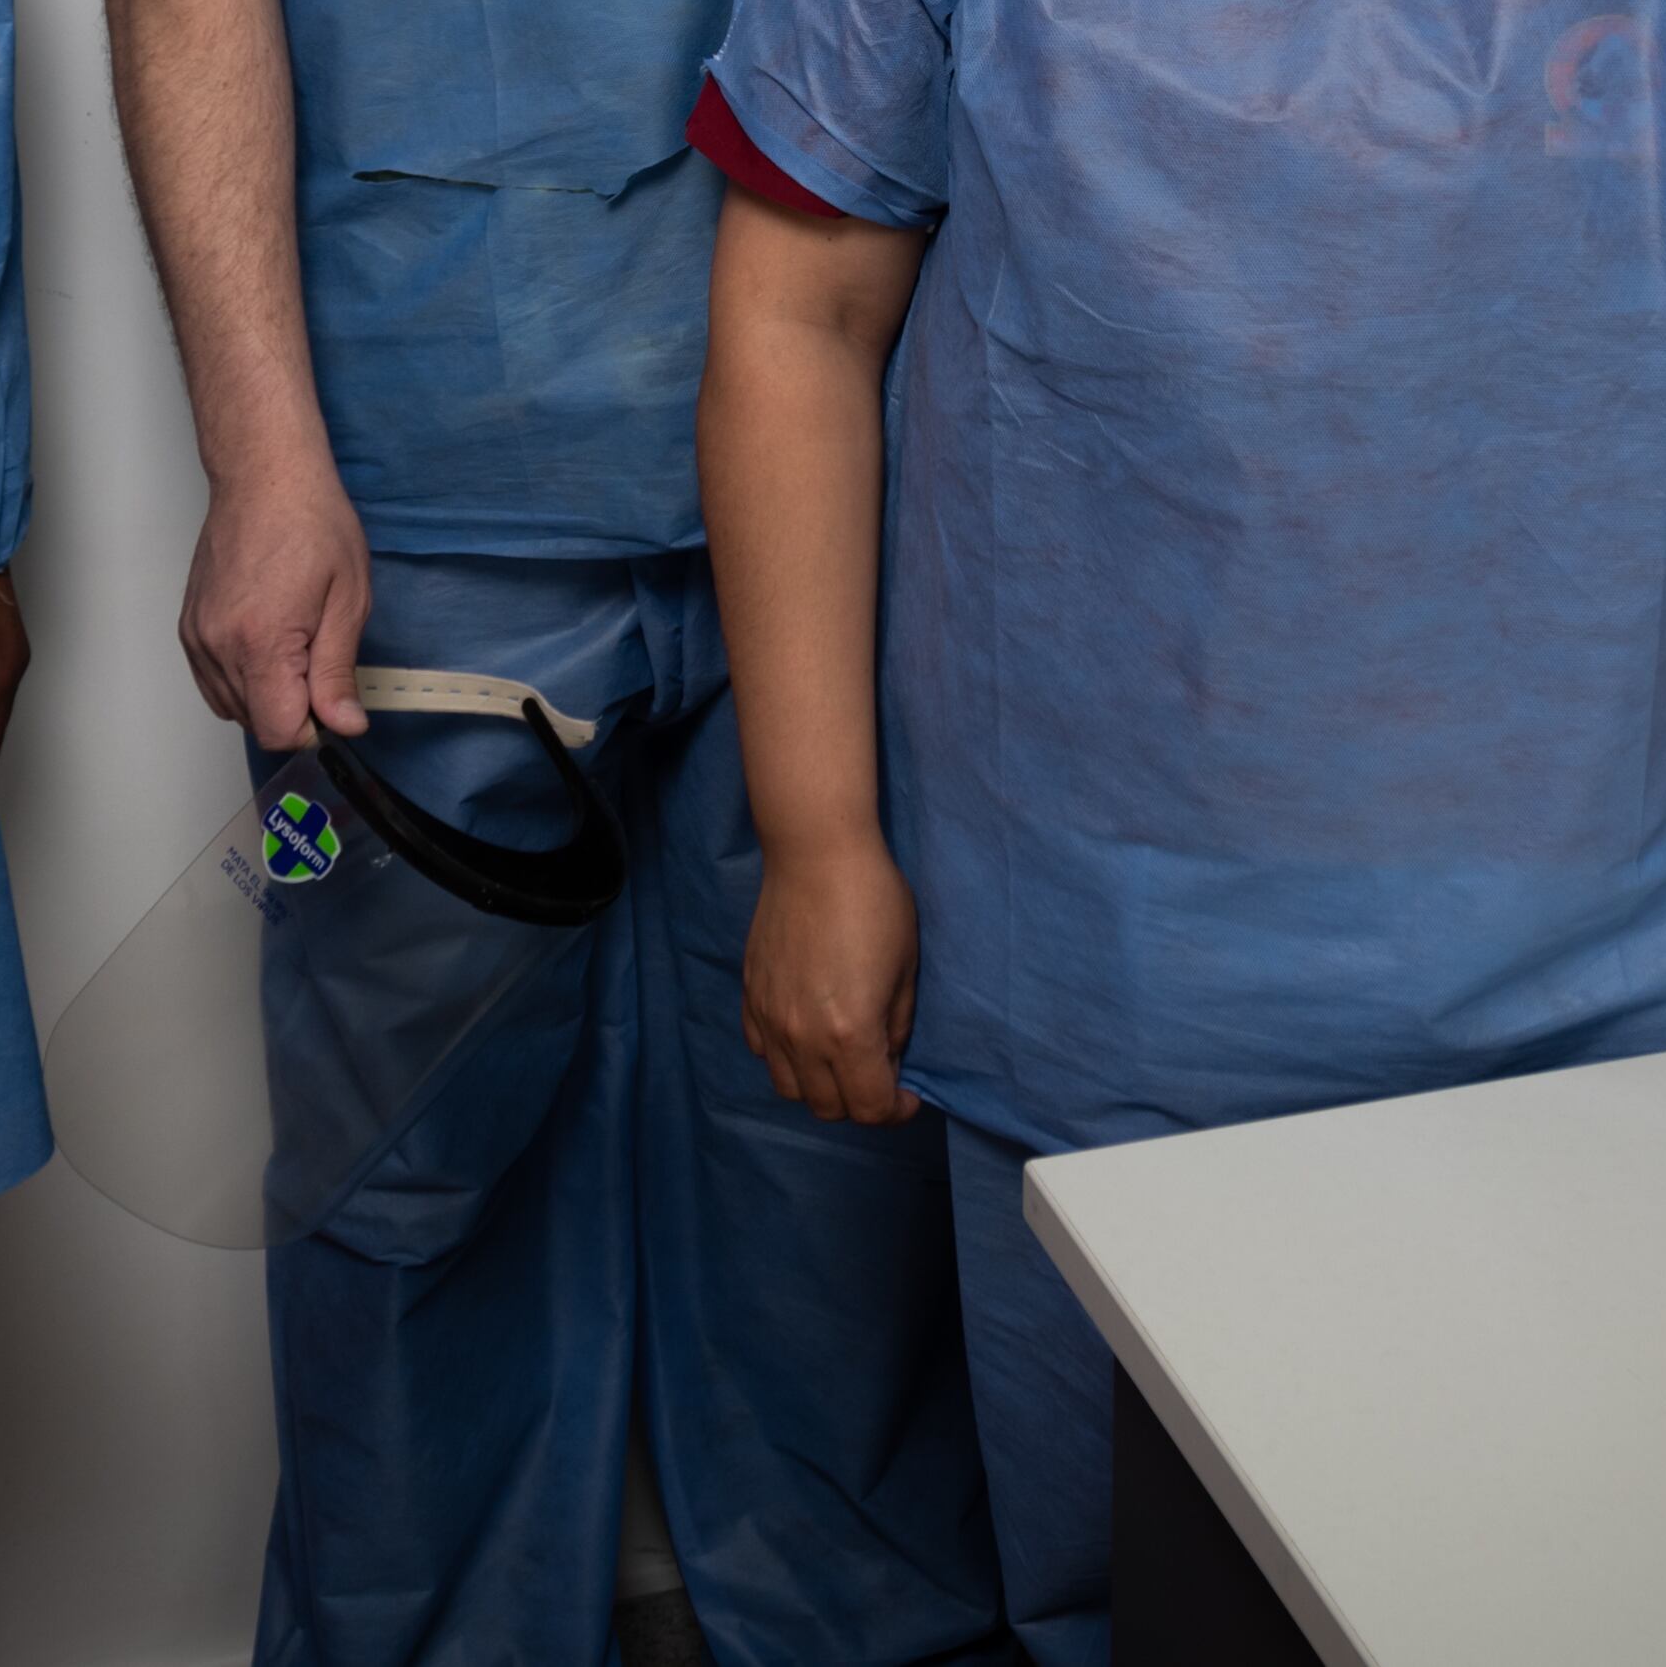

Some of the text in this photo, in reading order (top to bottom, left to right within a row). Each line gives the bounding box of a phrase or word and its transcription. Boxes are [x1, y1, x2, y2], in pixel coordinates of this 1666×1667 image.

[268, 808, 327, 871] Lysoform
[220, 859, 236, 878] DE
[233, 874, 253, 897] LOS
[227, 846, 261, 891] MATA EL
